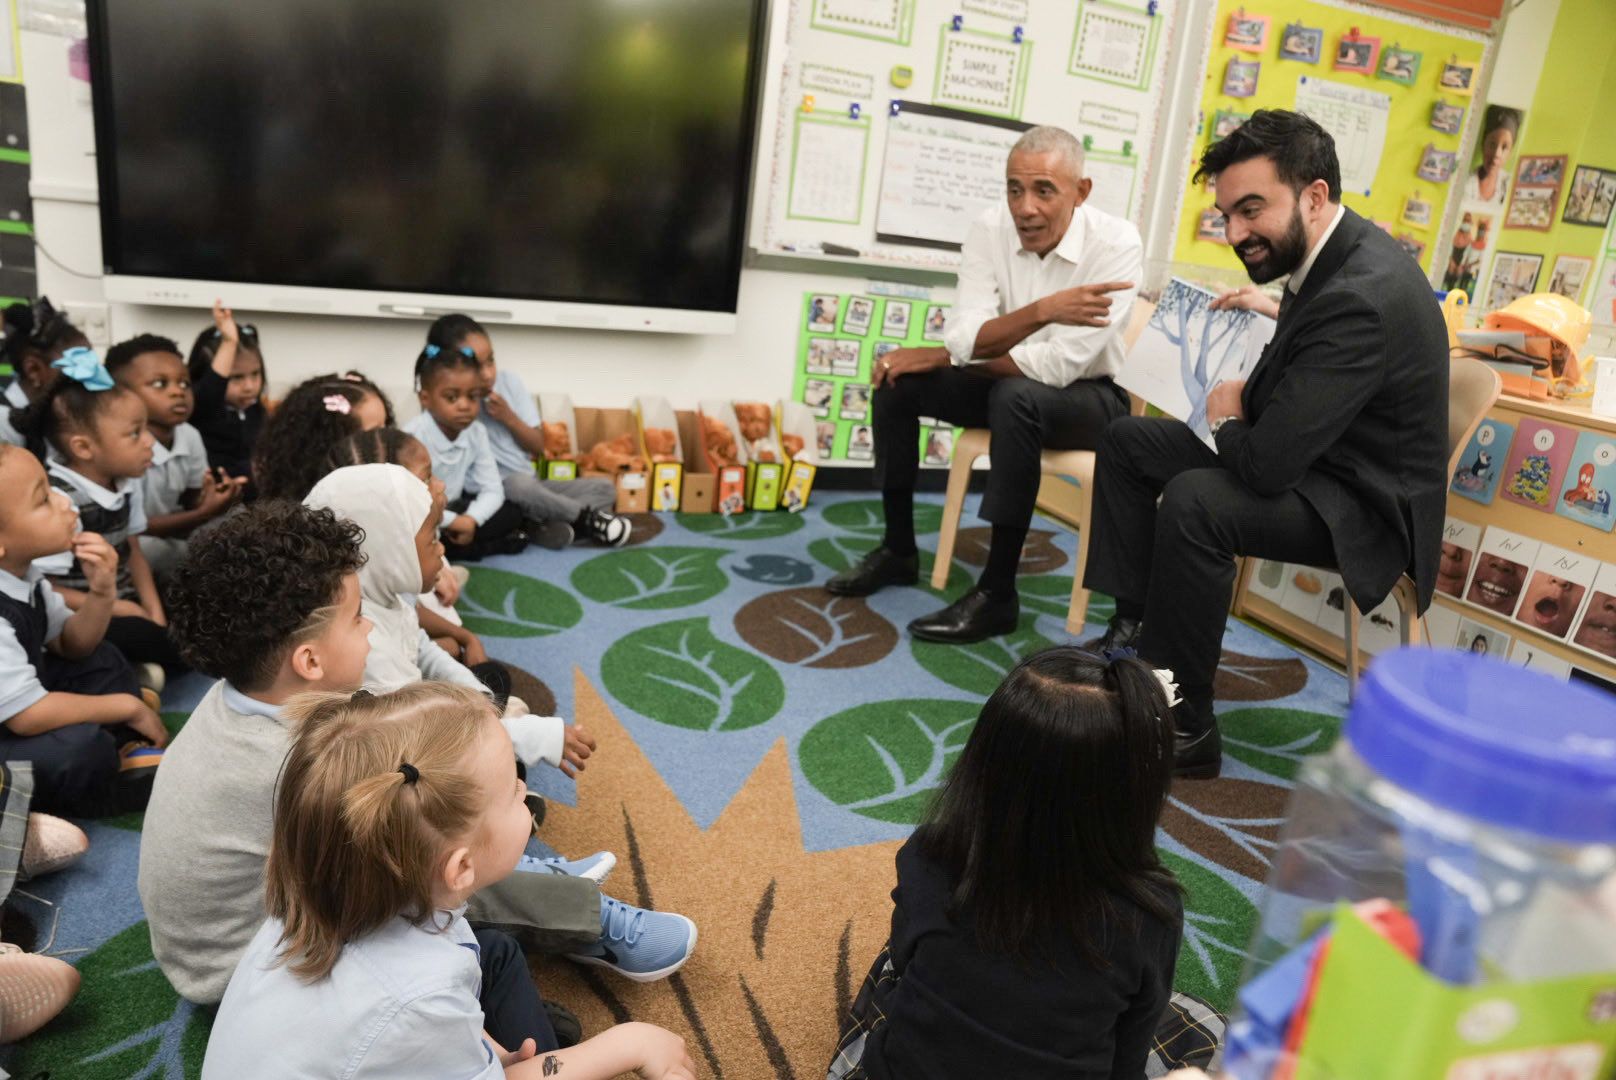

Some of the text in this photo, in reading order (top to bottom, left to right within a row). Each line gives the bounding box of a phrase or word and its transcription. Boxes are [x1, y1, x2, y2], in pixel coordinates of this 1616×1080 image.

[963, 59, 997, 76] SIMPLE
[951, 74, 1005, 93] MACHINES
[1482, 429, 1490, 442] p
[1540, 435, 1547, 444] n
[1601, 450, 1609, 458] o
[1499, 537, 1522, 551] /n/
